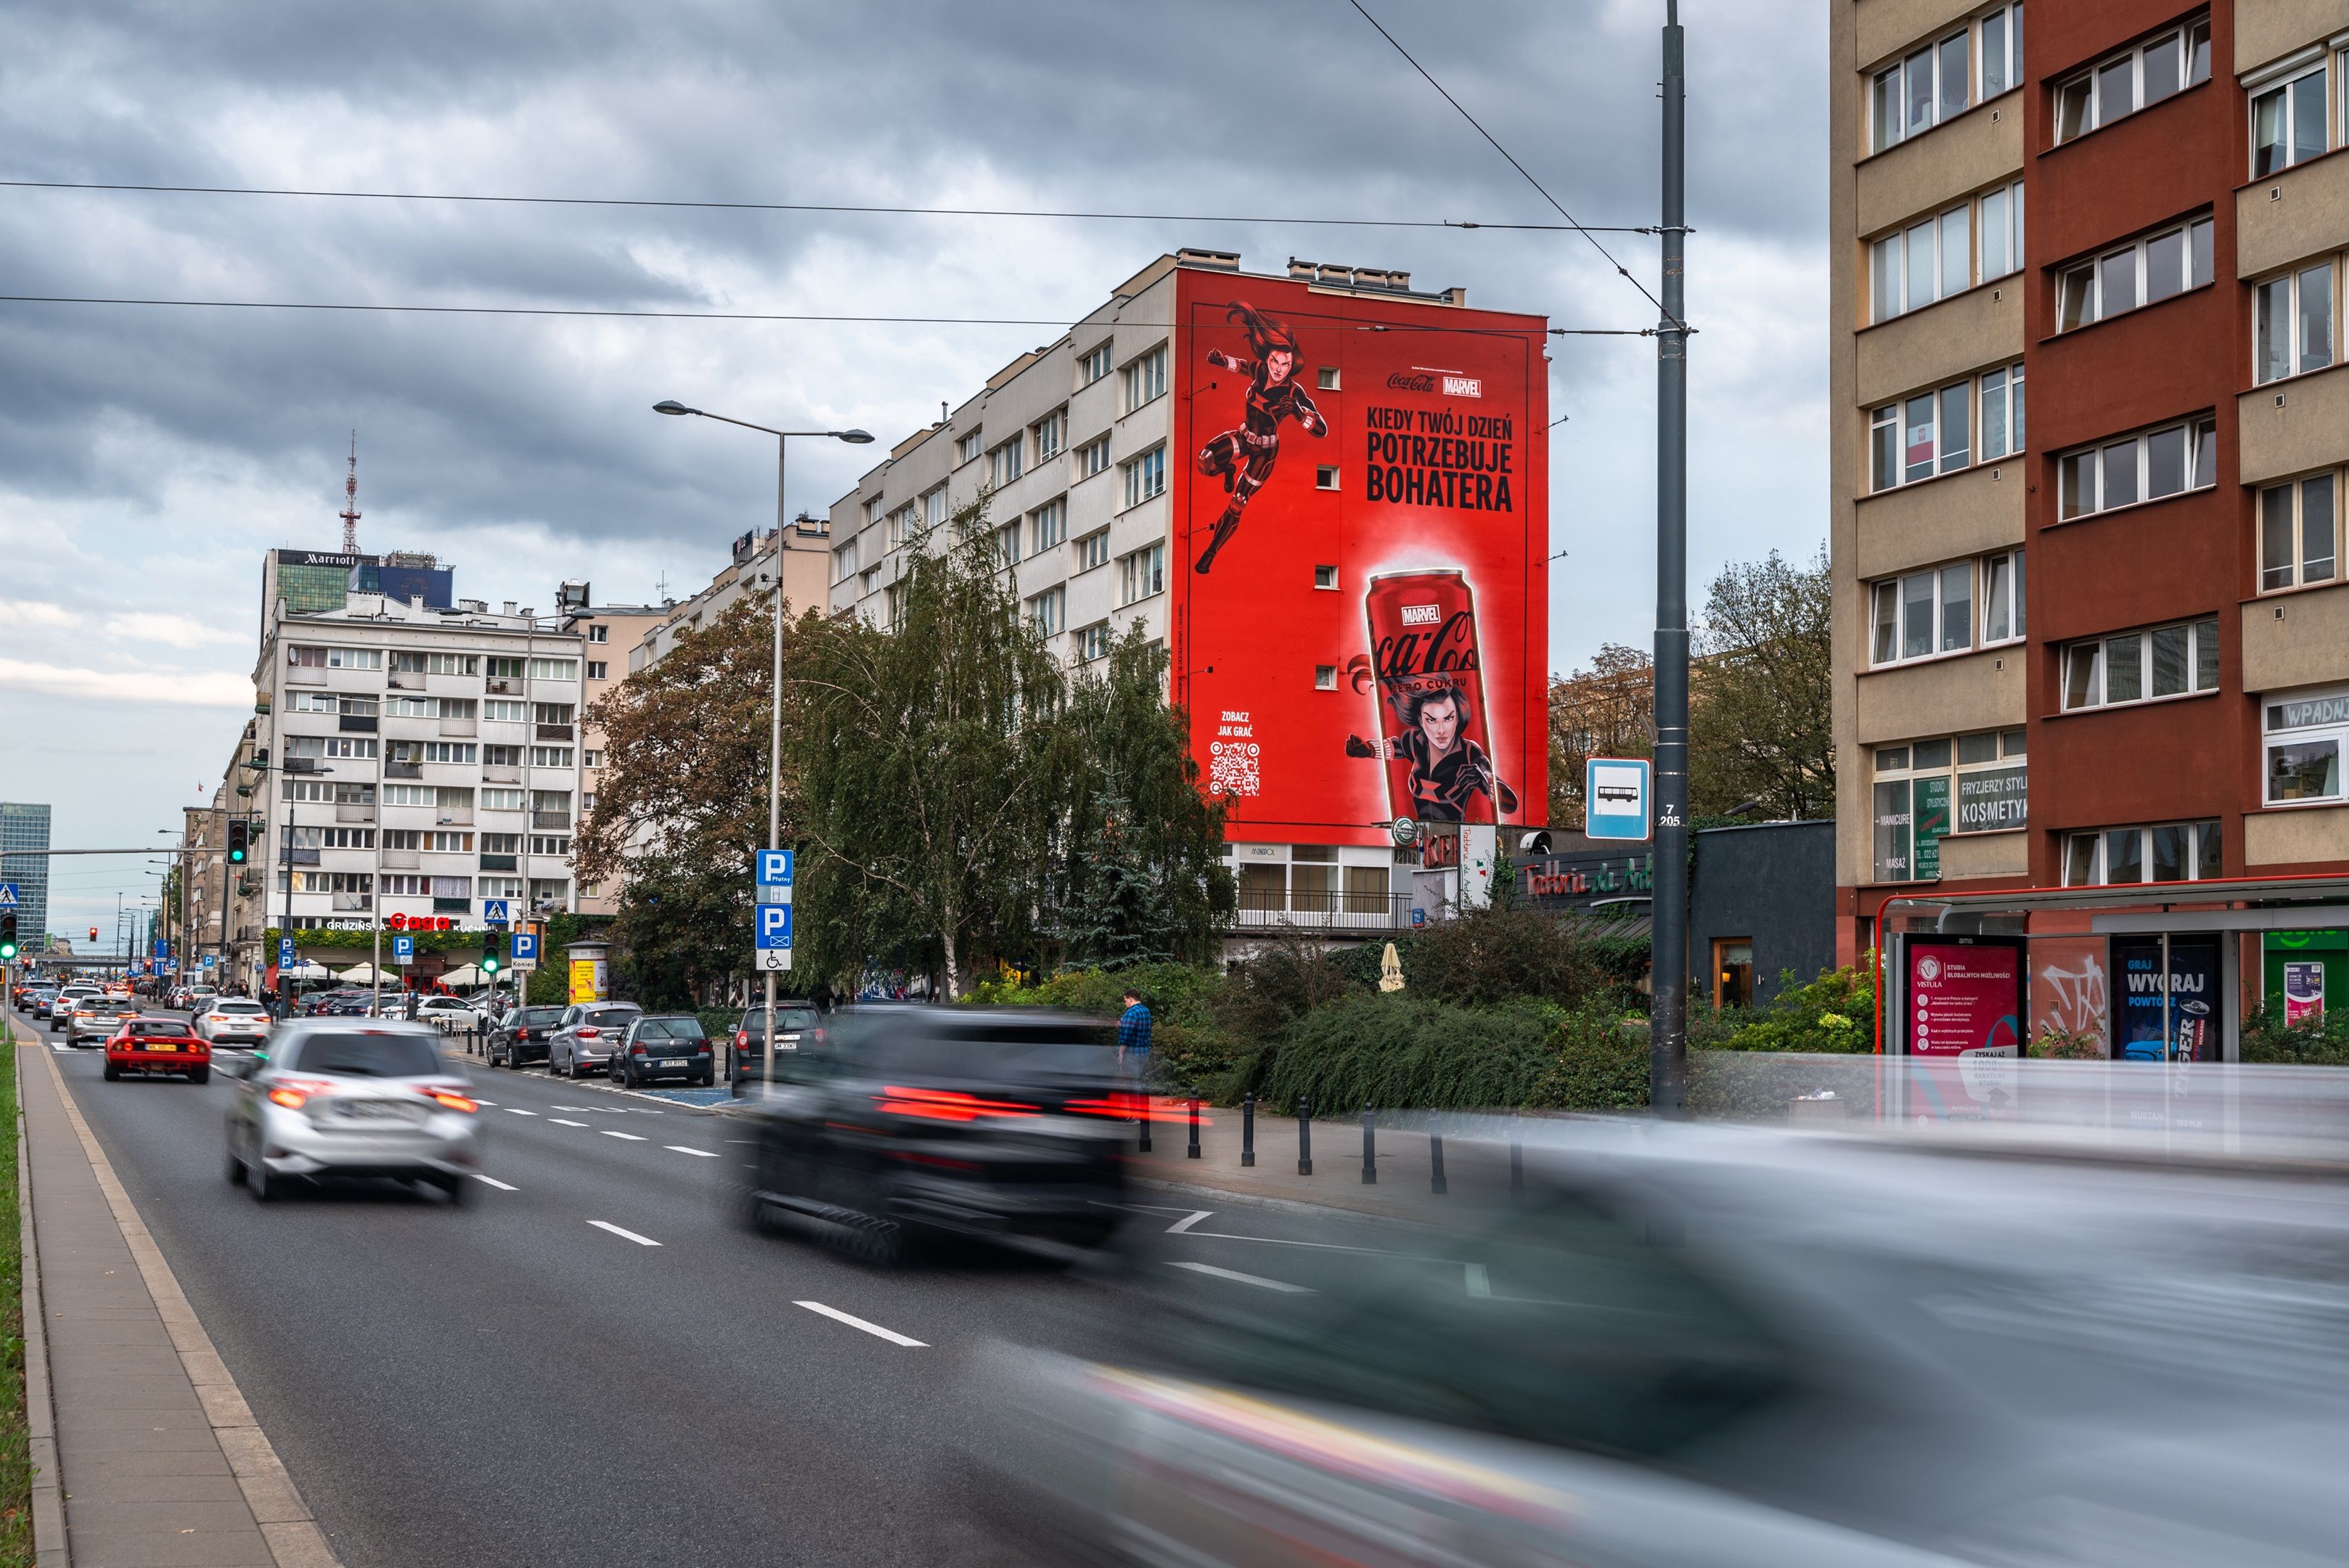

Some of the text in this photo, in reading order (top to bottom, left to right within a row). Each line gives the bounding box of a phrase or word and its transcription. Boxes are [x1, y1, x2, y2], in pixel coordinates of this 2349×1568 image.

[1386, 372, 1480, 396] Coca-Cola MARVEL
[1367, 407, 1513, 441] KIEDY TWÓJ DZIEŃ
[1367, 431, 1513, 474] POTRZEBUJE
[1367, 464, 1513, 513] BOHATERA
[305, 553, 355, 565] Marriott
[1402, 606, 1439, 624] MARVEL
[1391, 677, 1467, 693] ZERO CUKRU
[1221, 711, 1250, 723] ZOBACZ
[1217, 724, 1254, 738] JAK GRAĆ
[1961, 775, 2027, 796] FRYZJERZY STYLI
[1665, 804, 1675, 814] 7
[1961, 798, 2027, 823] KOSMETYK
[1659, 815, 1680, 826] 205
[1880, 814, 1911, 826] MANICURE
[1463, 827, 1471, 862] Trattoria
[765, 854, 786, 881] P
[1886, 854, 1906, 869] MASAŻ
[1521, 859, 1591, 896] Trattoria
[1591, 862, 1620, 894] da
[390, 912, 450, 931] Gaga
[764, 908, 785, 936] P
[398, 939, 409, 954] P
[517, 936, 532, 956] P
[282, 956, 291, 968] P
[2128, 959, 2152, 970] GRAJ
[1980, 971, 2011, 979] MOŻLIWOŚCI
[2128, 994, 2176, 1007] POWTÓZ
[2130, 1111, 2165, 1120] MUSTAN
